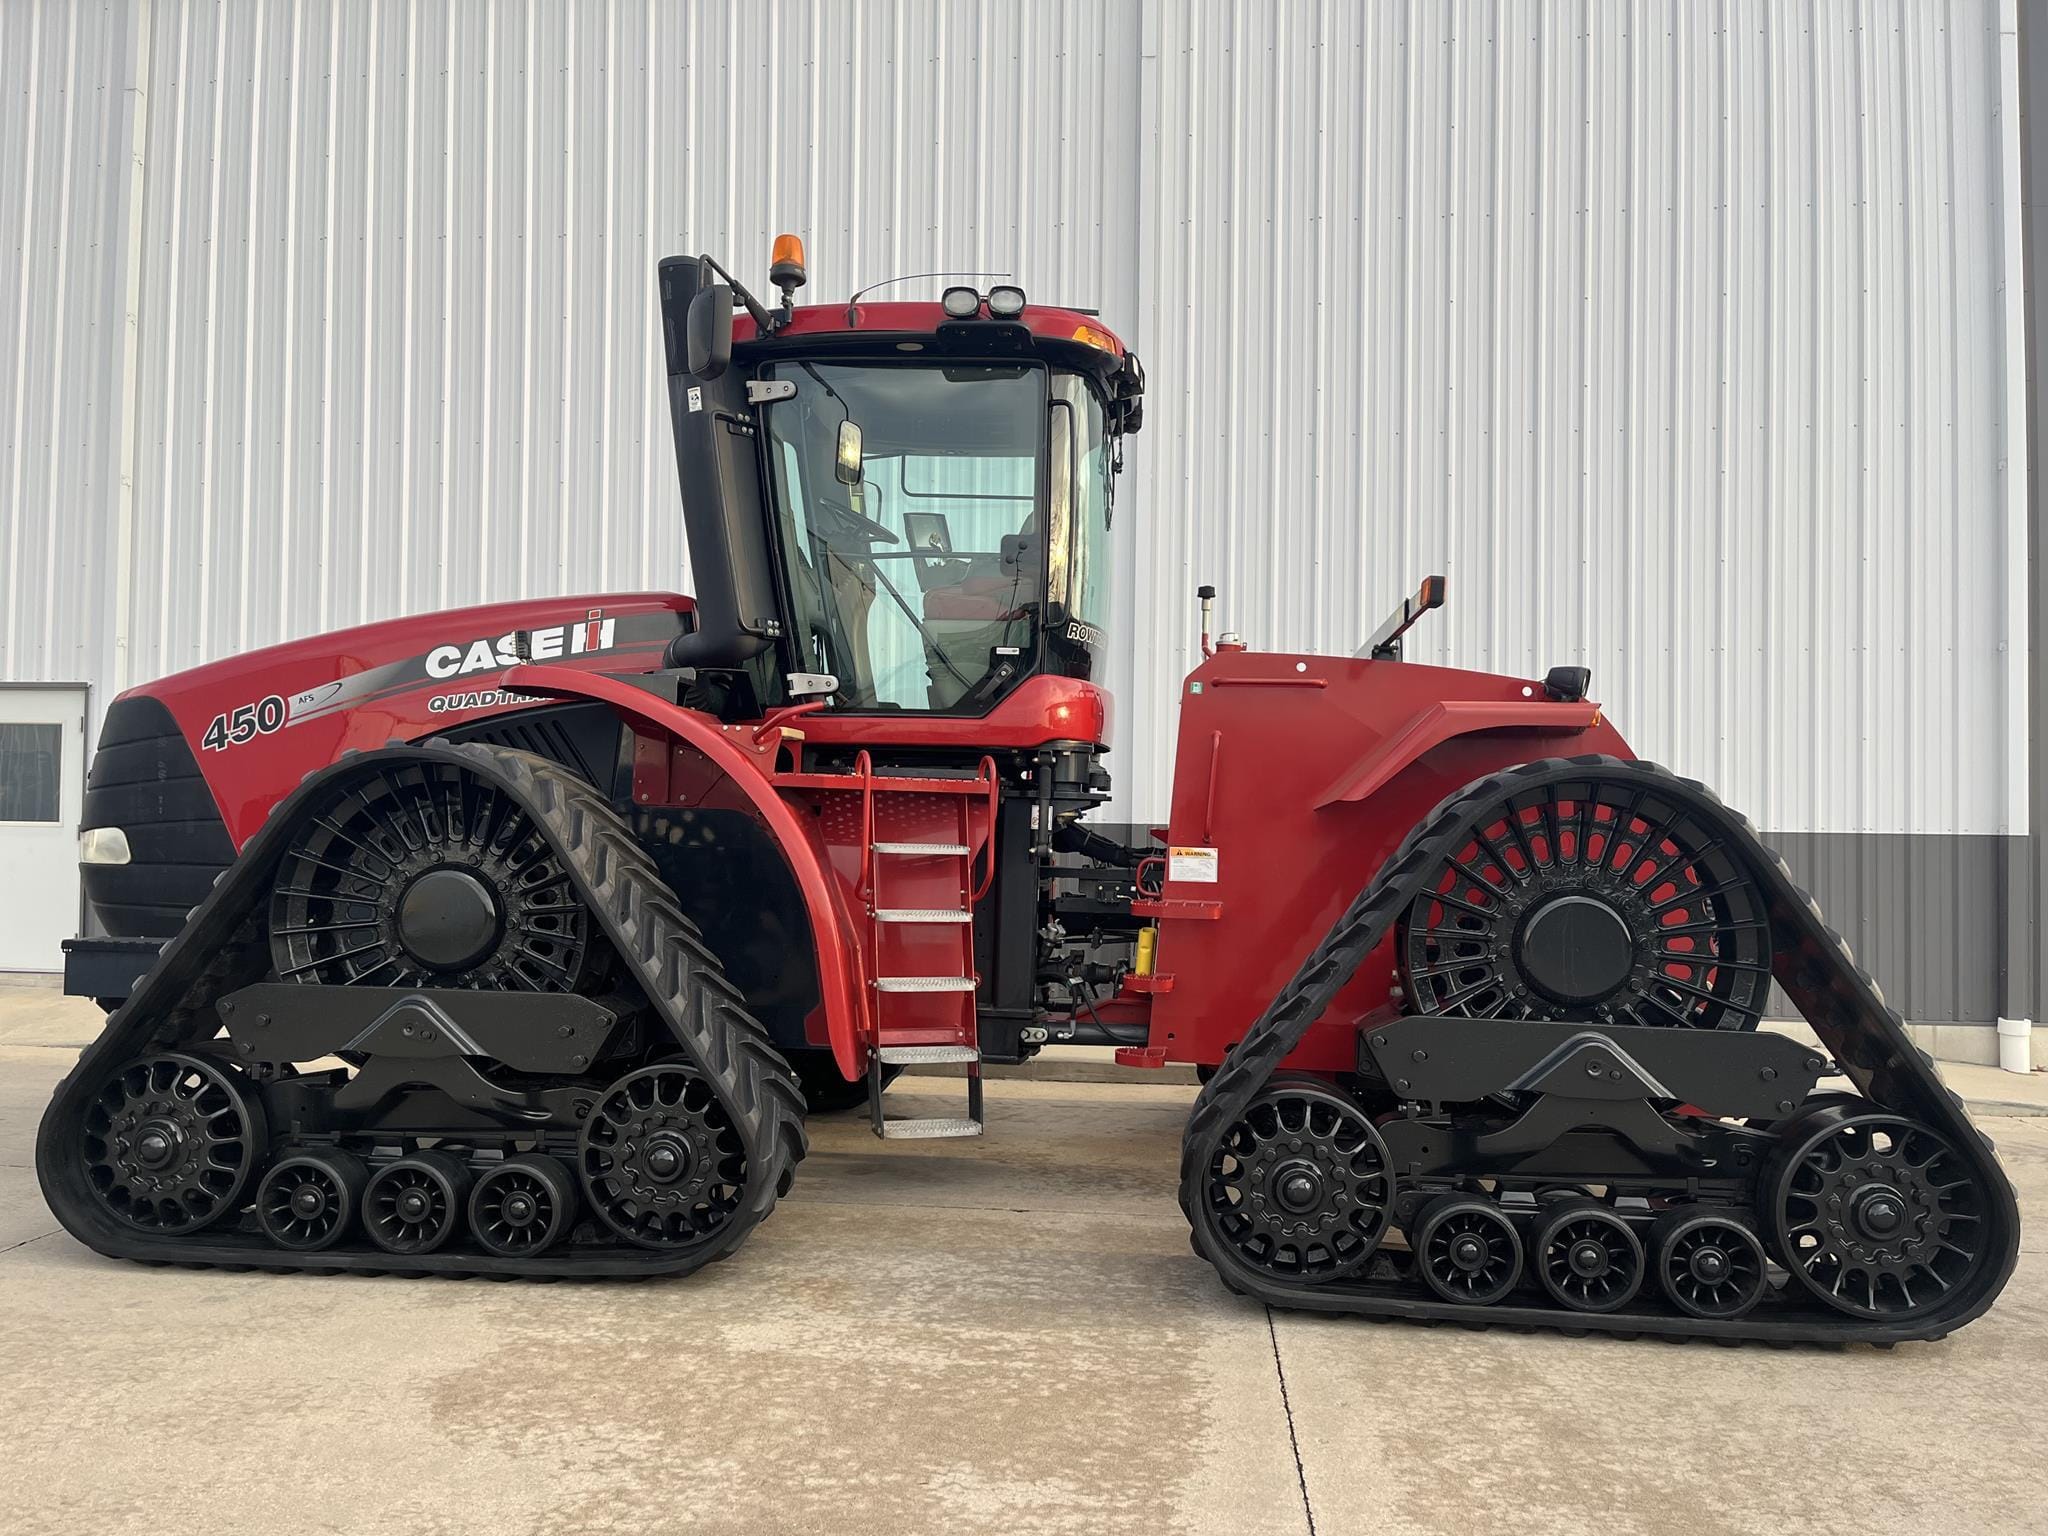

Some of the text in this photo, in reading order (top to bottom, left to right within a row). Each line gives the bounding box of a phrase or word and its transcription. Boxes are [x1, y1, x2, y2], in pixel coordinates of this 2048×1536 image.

[425, 626, 565, 679] CASE
[202, 694, 286, 753] 450
[298, 694, 315, 705] AFS
